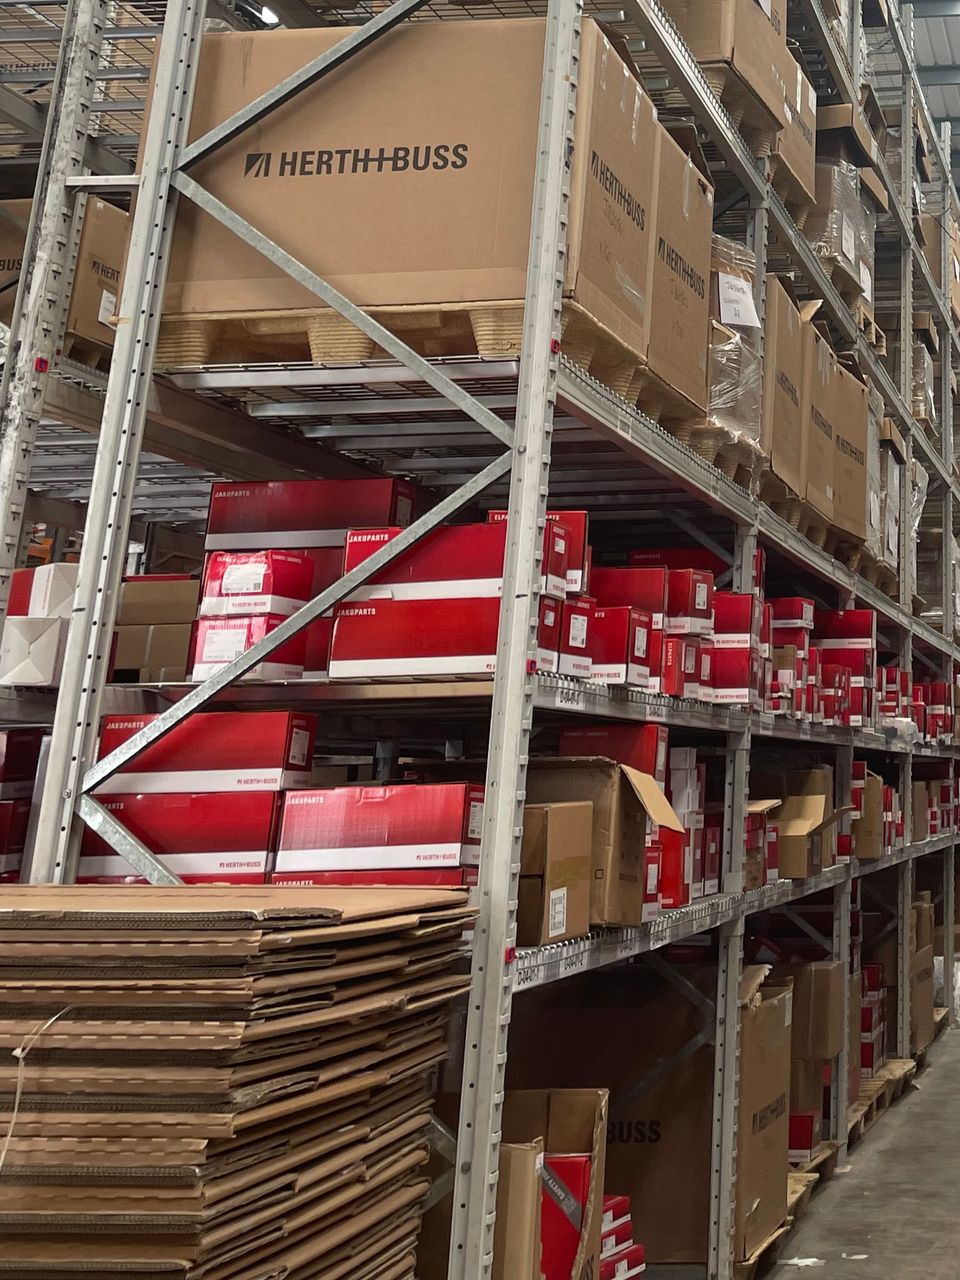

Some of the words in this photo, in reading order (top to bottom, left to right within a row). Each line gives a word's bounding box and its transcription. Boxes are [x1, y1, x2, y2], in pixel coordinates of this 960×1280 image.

[279, 144, 469, 177] HERTH+BUSS
[600, 160, 645, 231] HERTH+BUSS
[666, 244, 705, 299] HERTH+BUSS
[349, 534, 389, 543] JAKOPARTS
[337, 608, 376, 616] JAKOPARTS
